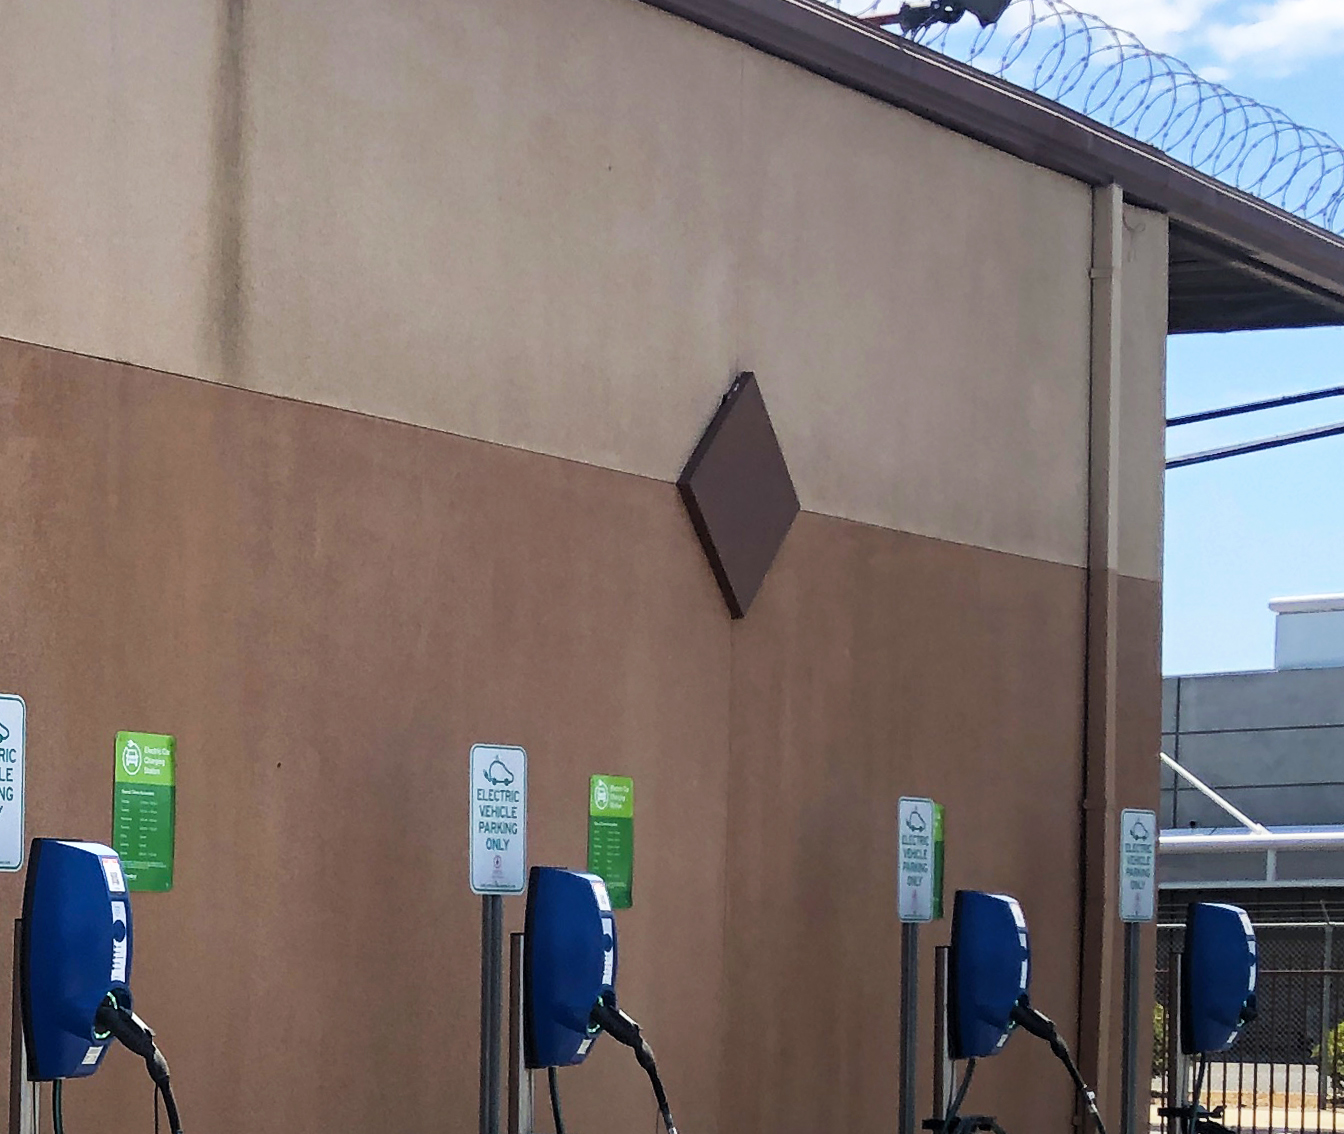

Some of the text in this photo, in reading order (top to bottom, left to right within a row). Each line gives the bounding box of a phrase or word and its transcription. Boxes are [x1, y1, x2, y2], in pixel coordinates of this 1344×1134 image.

[477, 788, 520, 803] ELECTRIC
[478, 805, 518, 819] VEHICLE
[478, 821, 518, 835] PARKING
[485, 838, 510, 851] ONLY
